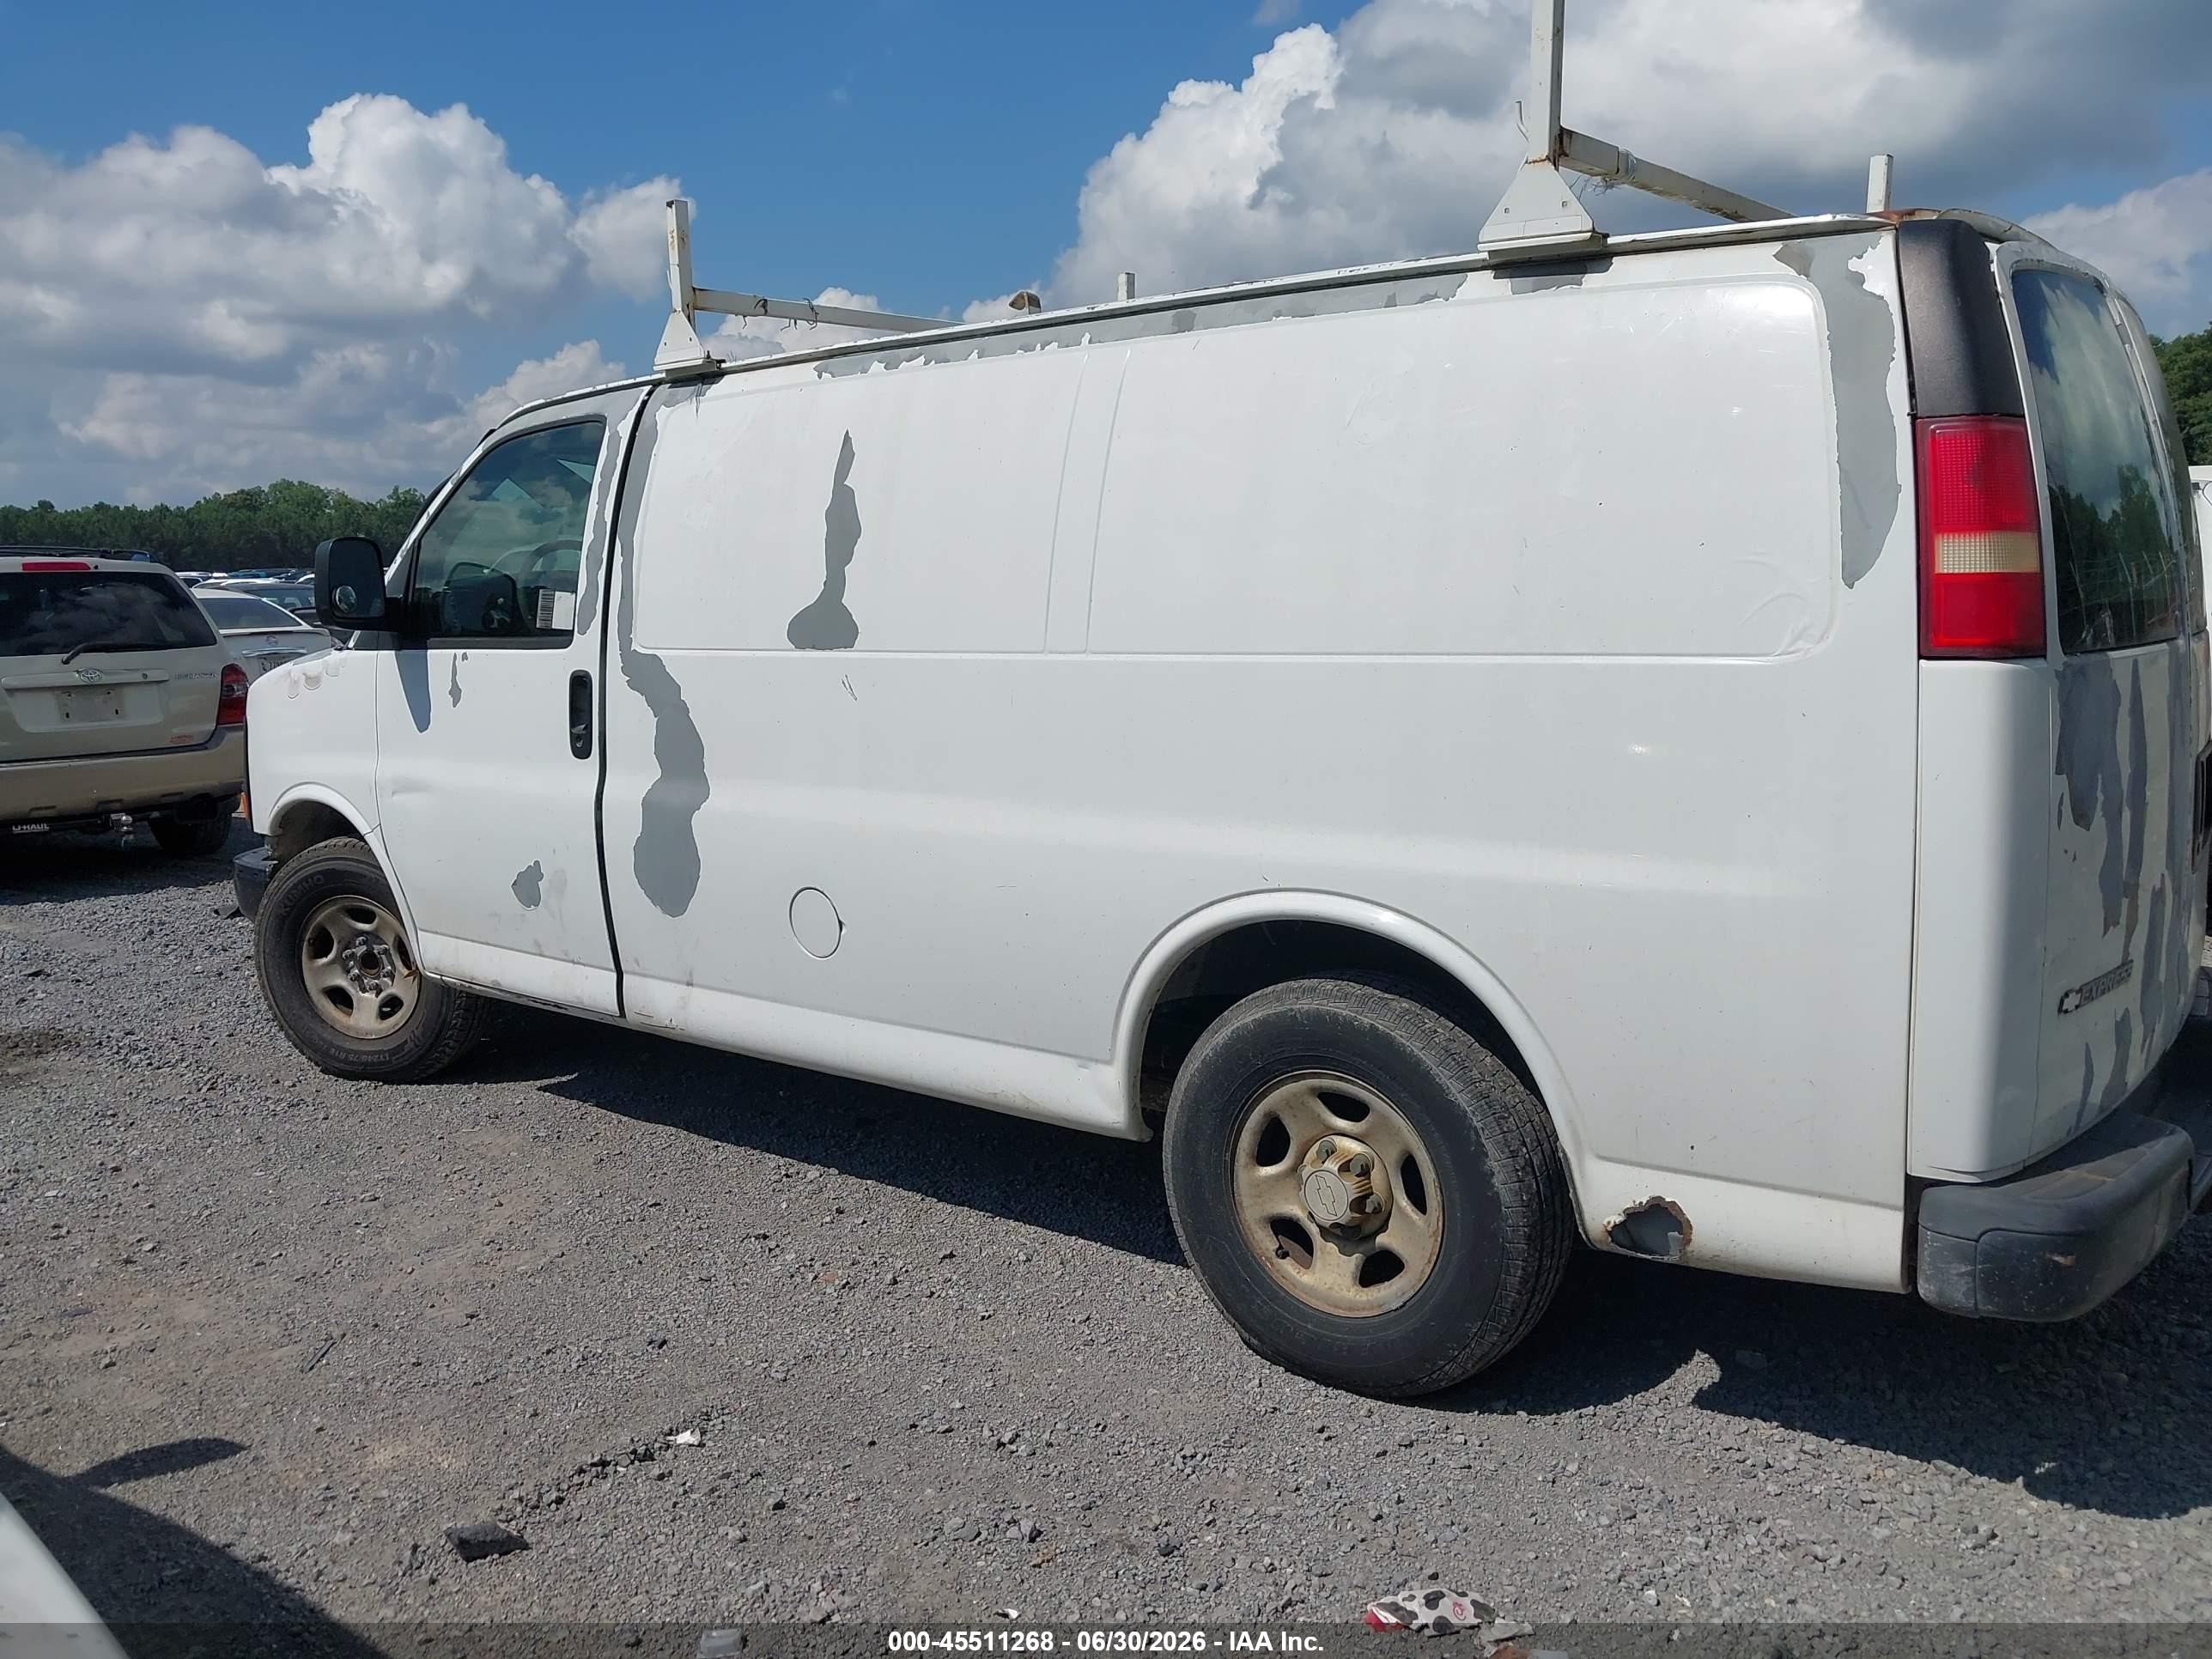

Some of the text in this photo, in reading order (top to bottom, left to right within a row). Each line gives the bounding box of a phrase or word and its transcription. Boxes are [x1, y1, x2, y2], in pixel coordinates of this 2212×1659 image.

[12, 823, 50, 831] U-HAUL
[279, 874, 325, 916] KUMHO
[2081, 963, 2133, 1004] EXPRESS
